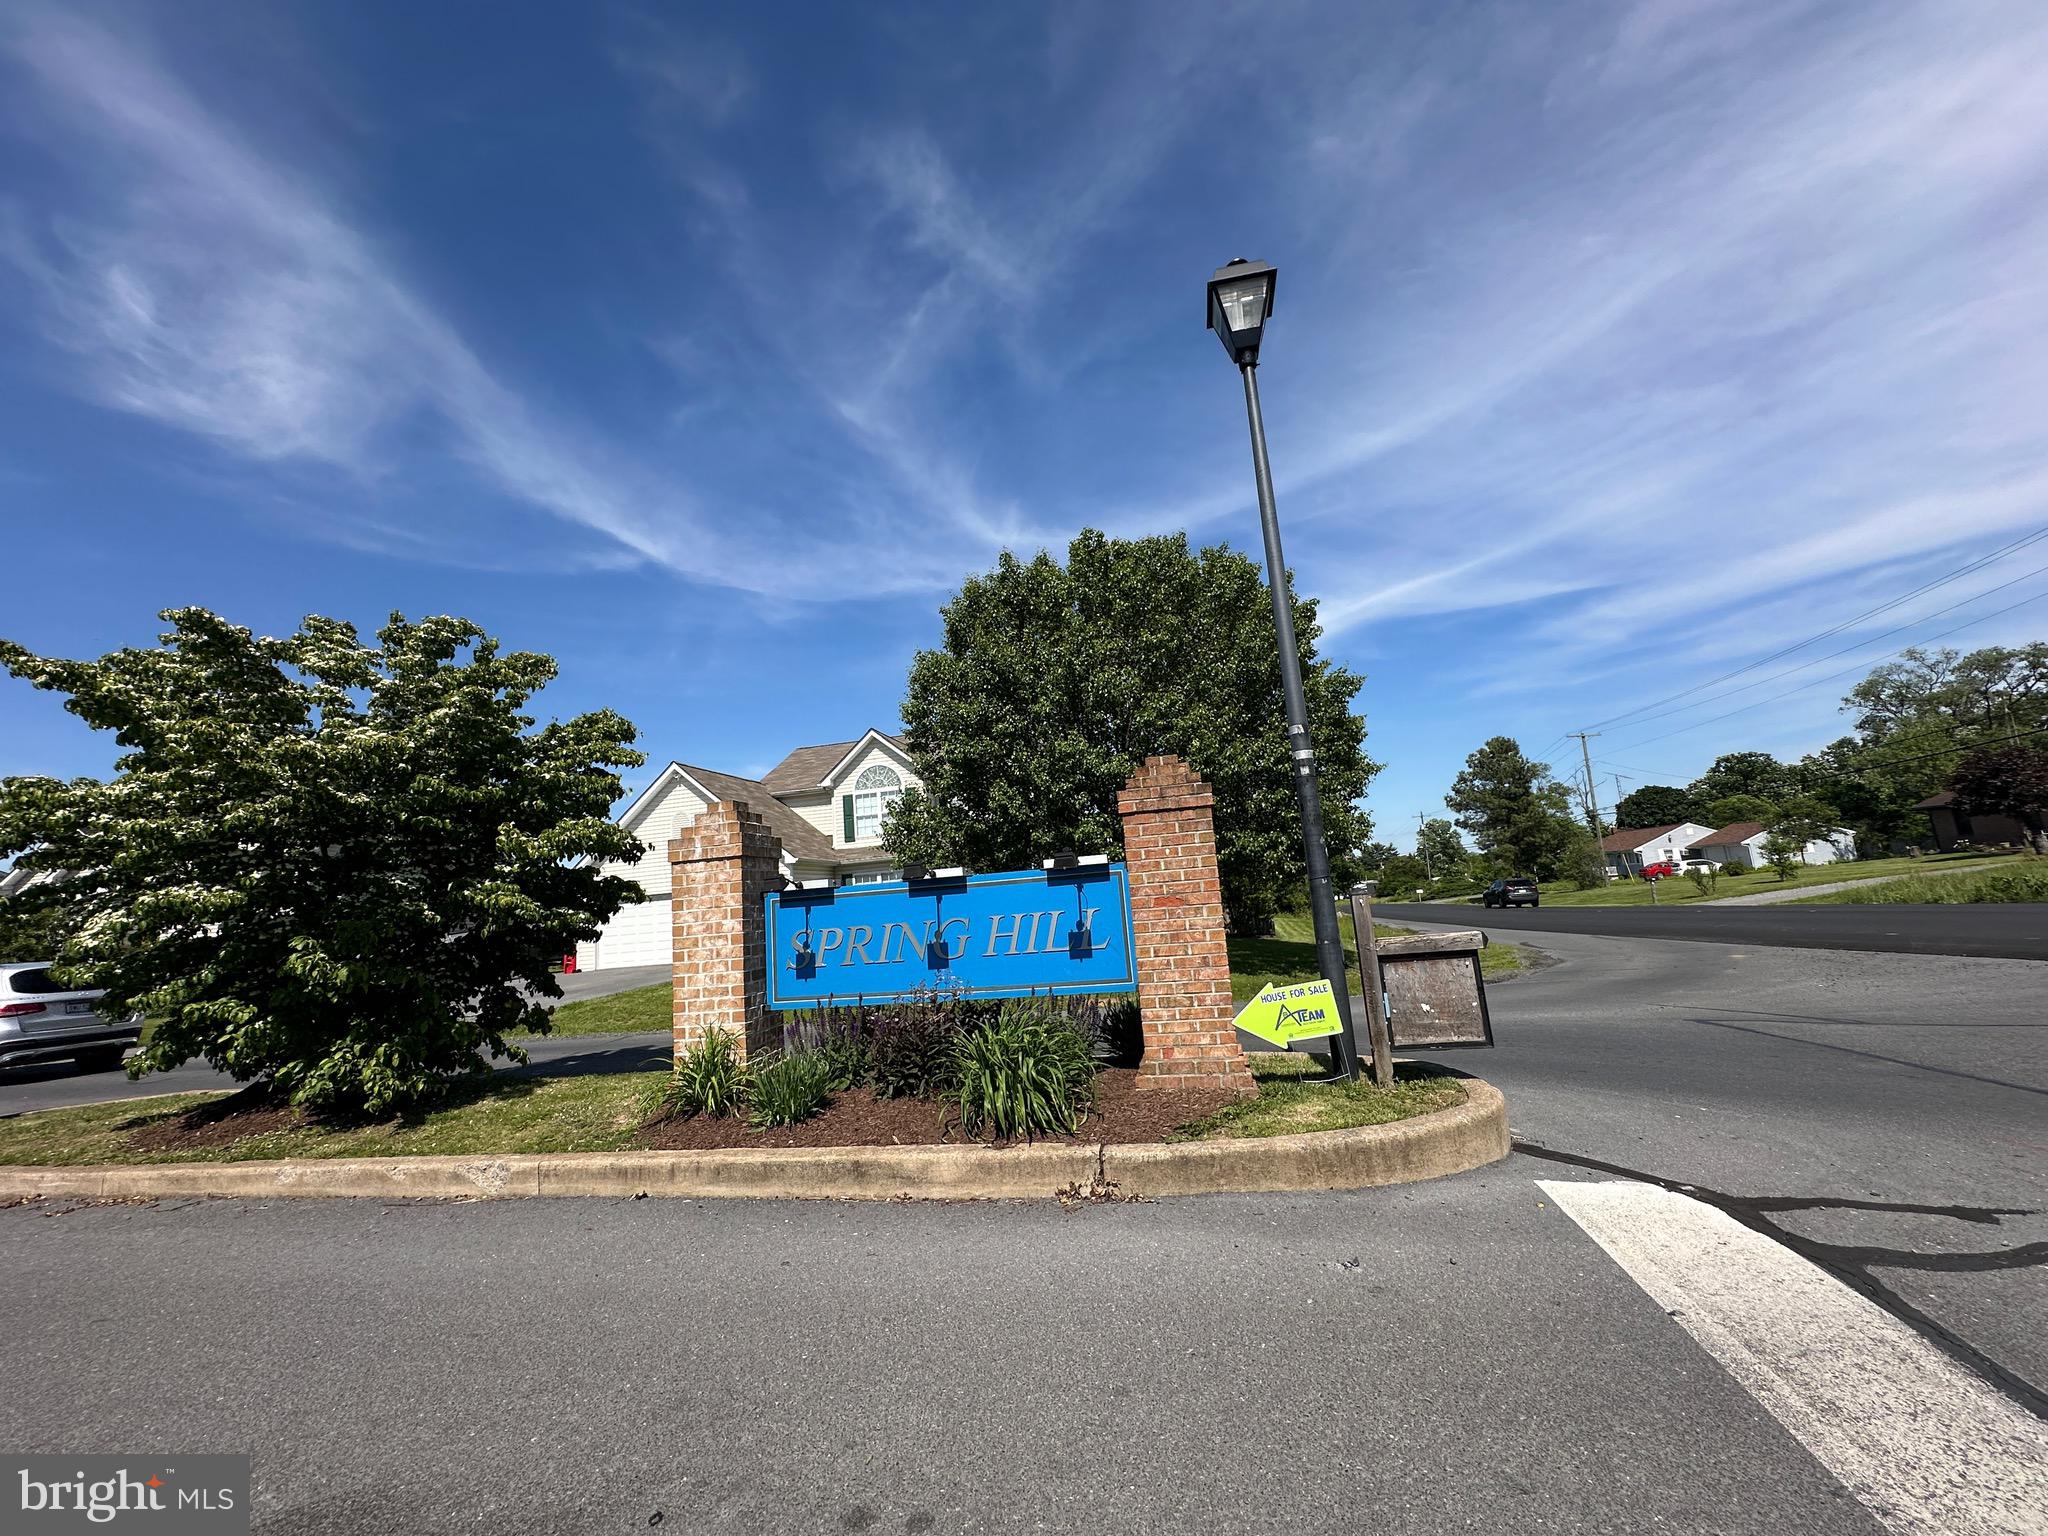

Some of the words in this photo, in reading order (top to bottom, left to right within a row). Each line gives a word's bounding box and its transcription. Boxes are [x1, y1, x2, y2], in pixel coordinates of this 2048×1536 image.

[786, 916, 971, 972] SPRING
[981, 907, 1112, 957] HILL
[1261, 991, 1287, 1003] HOUSE
[1290, 988, 1305, 998] FOR
[1308, 984, 1328, 995] SALE
